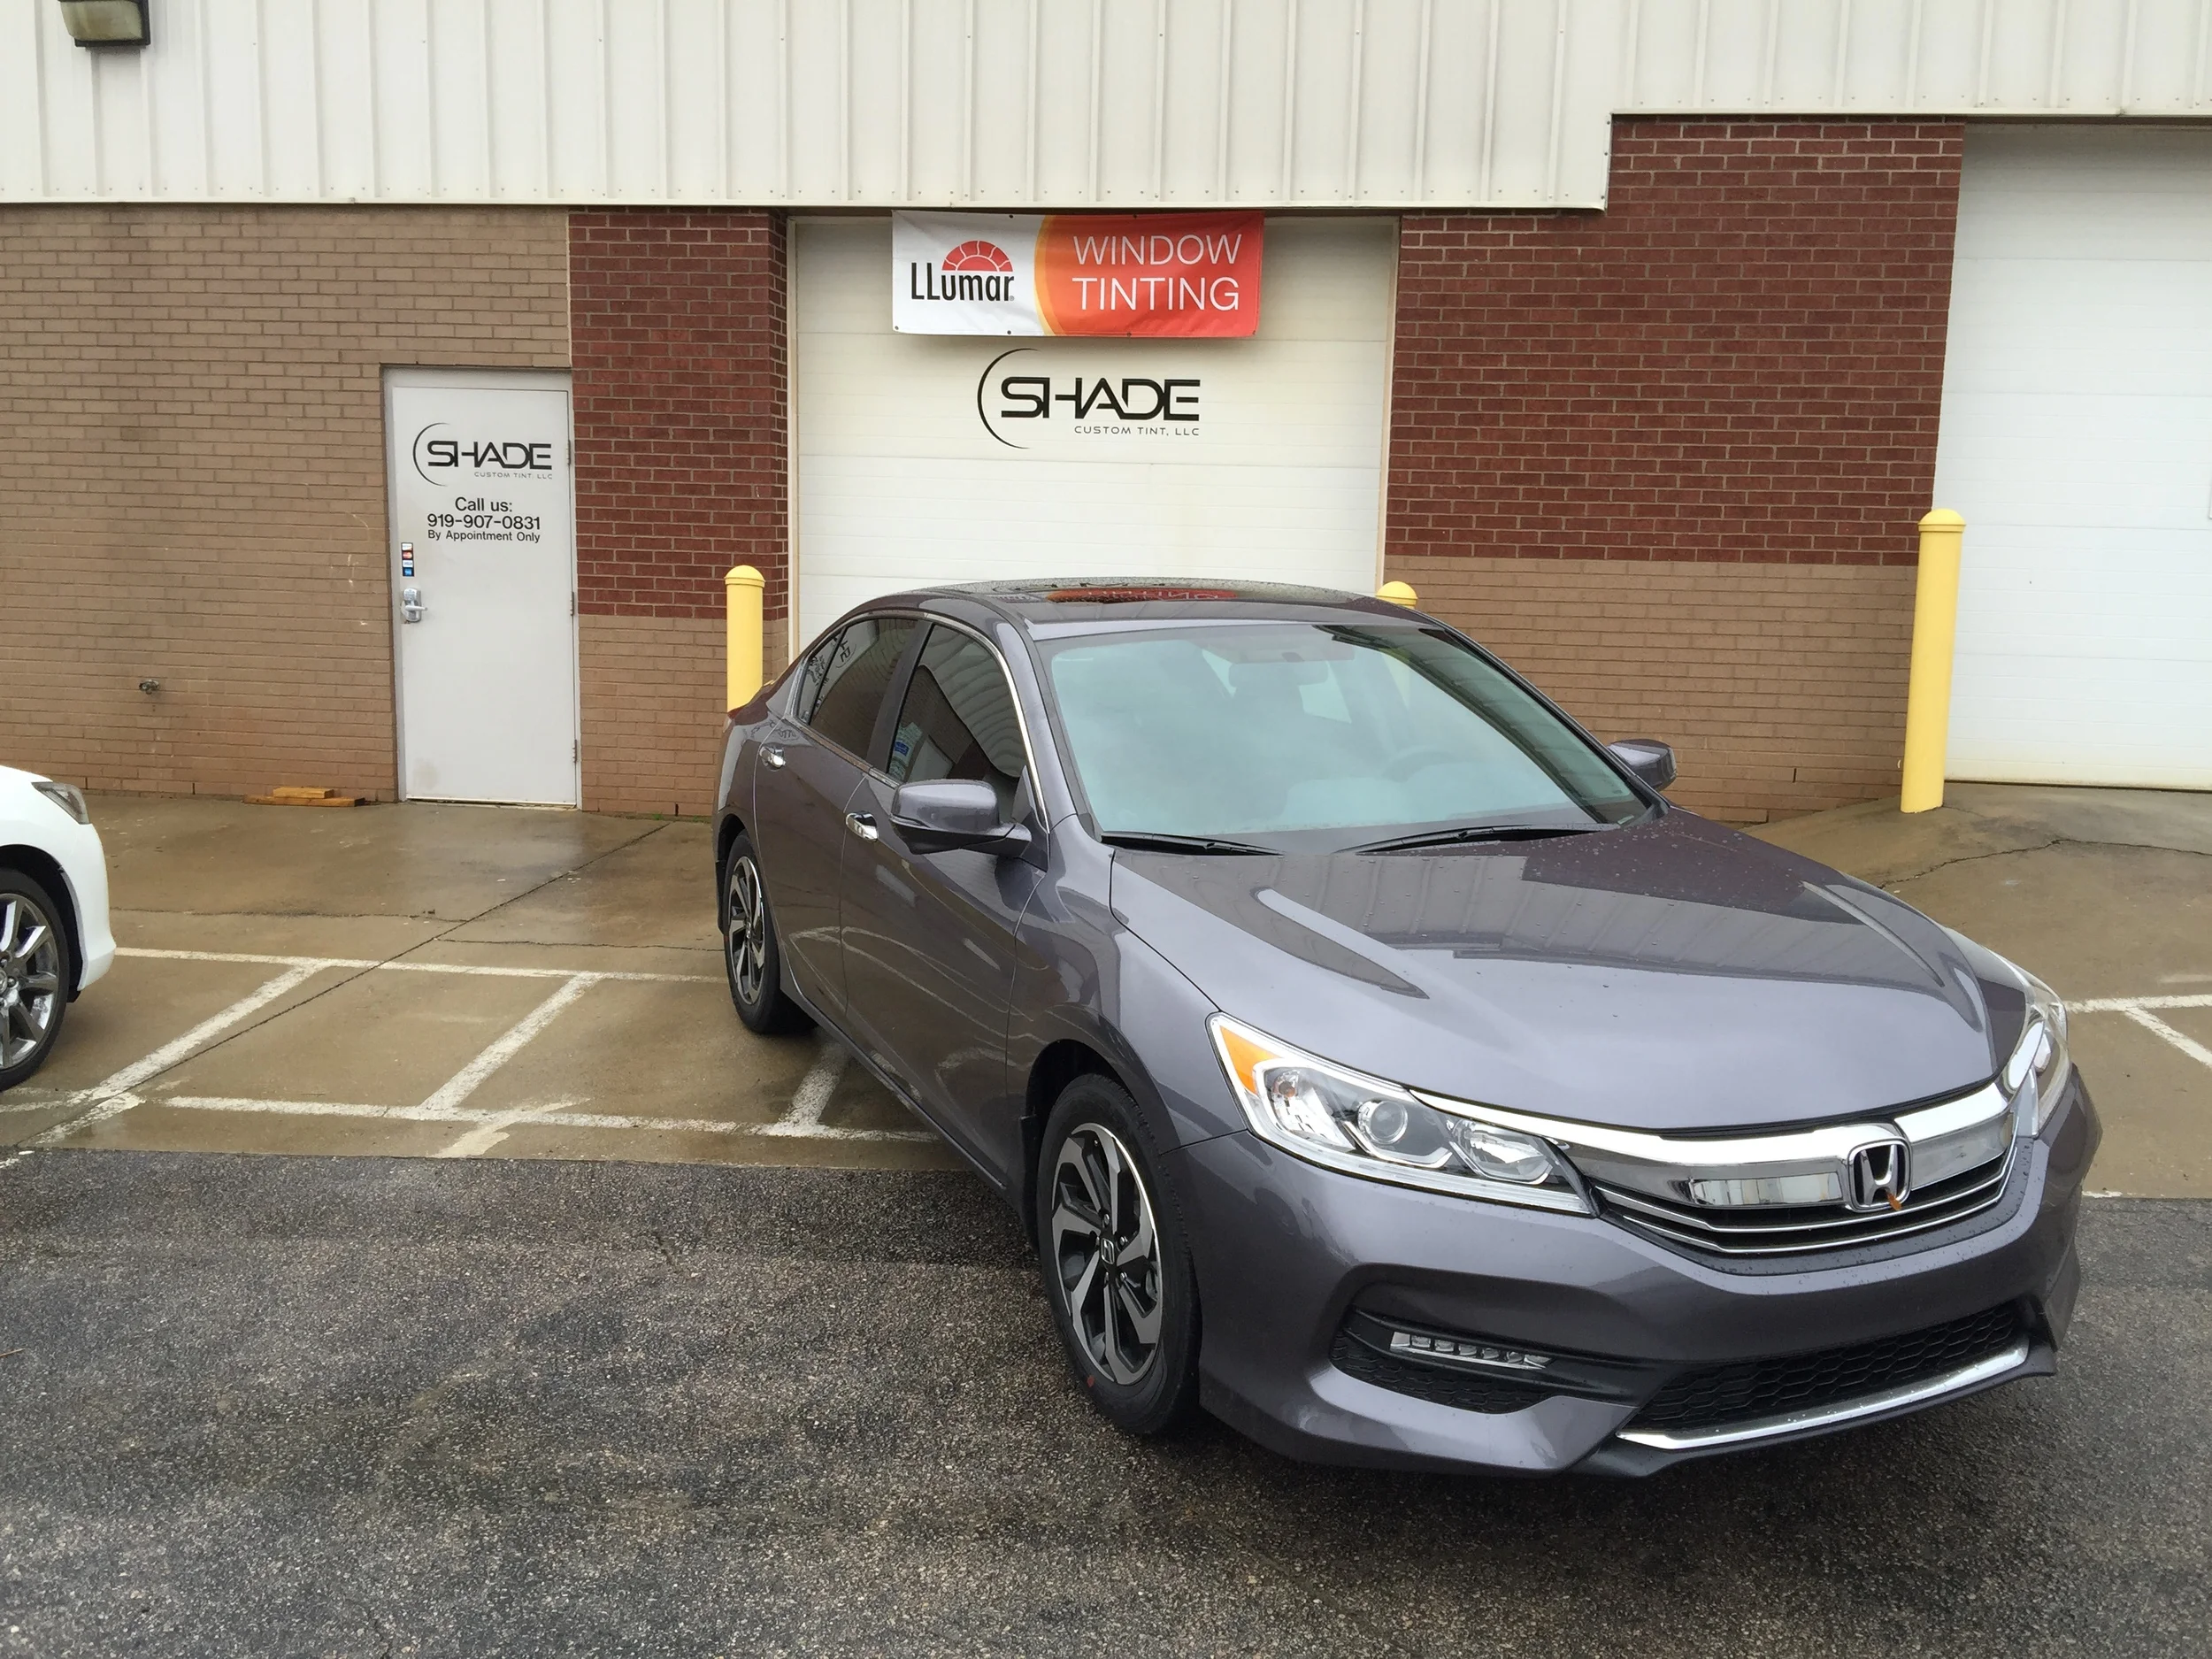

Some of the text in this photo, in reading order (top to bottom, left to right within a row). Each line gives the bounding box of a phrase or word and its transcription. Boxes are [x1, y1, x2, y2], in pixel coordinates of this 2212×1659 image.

[1073, 234, 1242, 265] WINDOW
[910, 262, 1015, 302] LLumar
[1071, 277, 1240, 311] TINTING
[1001, 376, 1201, 421] SHADE
[1074, 426, 1200, 436] CUSTOM TINT, LLC
[427, 441, 552, 470] SHADE
[455, 496, 513, 512] Call us:
[427, 513, 541, 530] 919-907-0831
[427, 529, 541, 543] By Appointment Only
